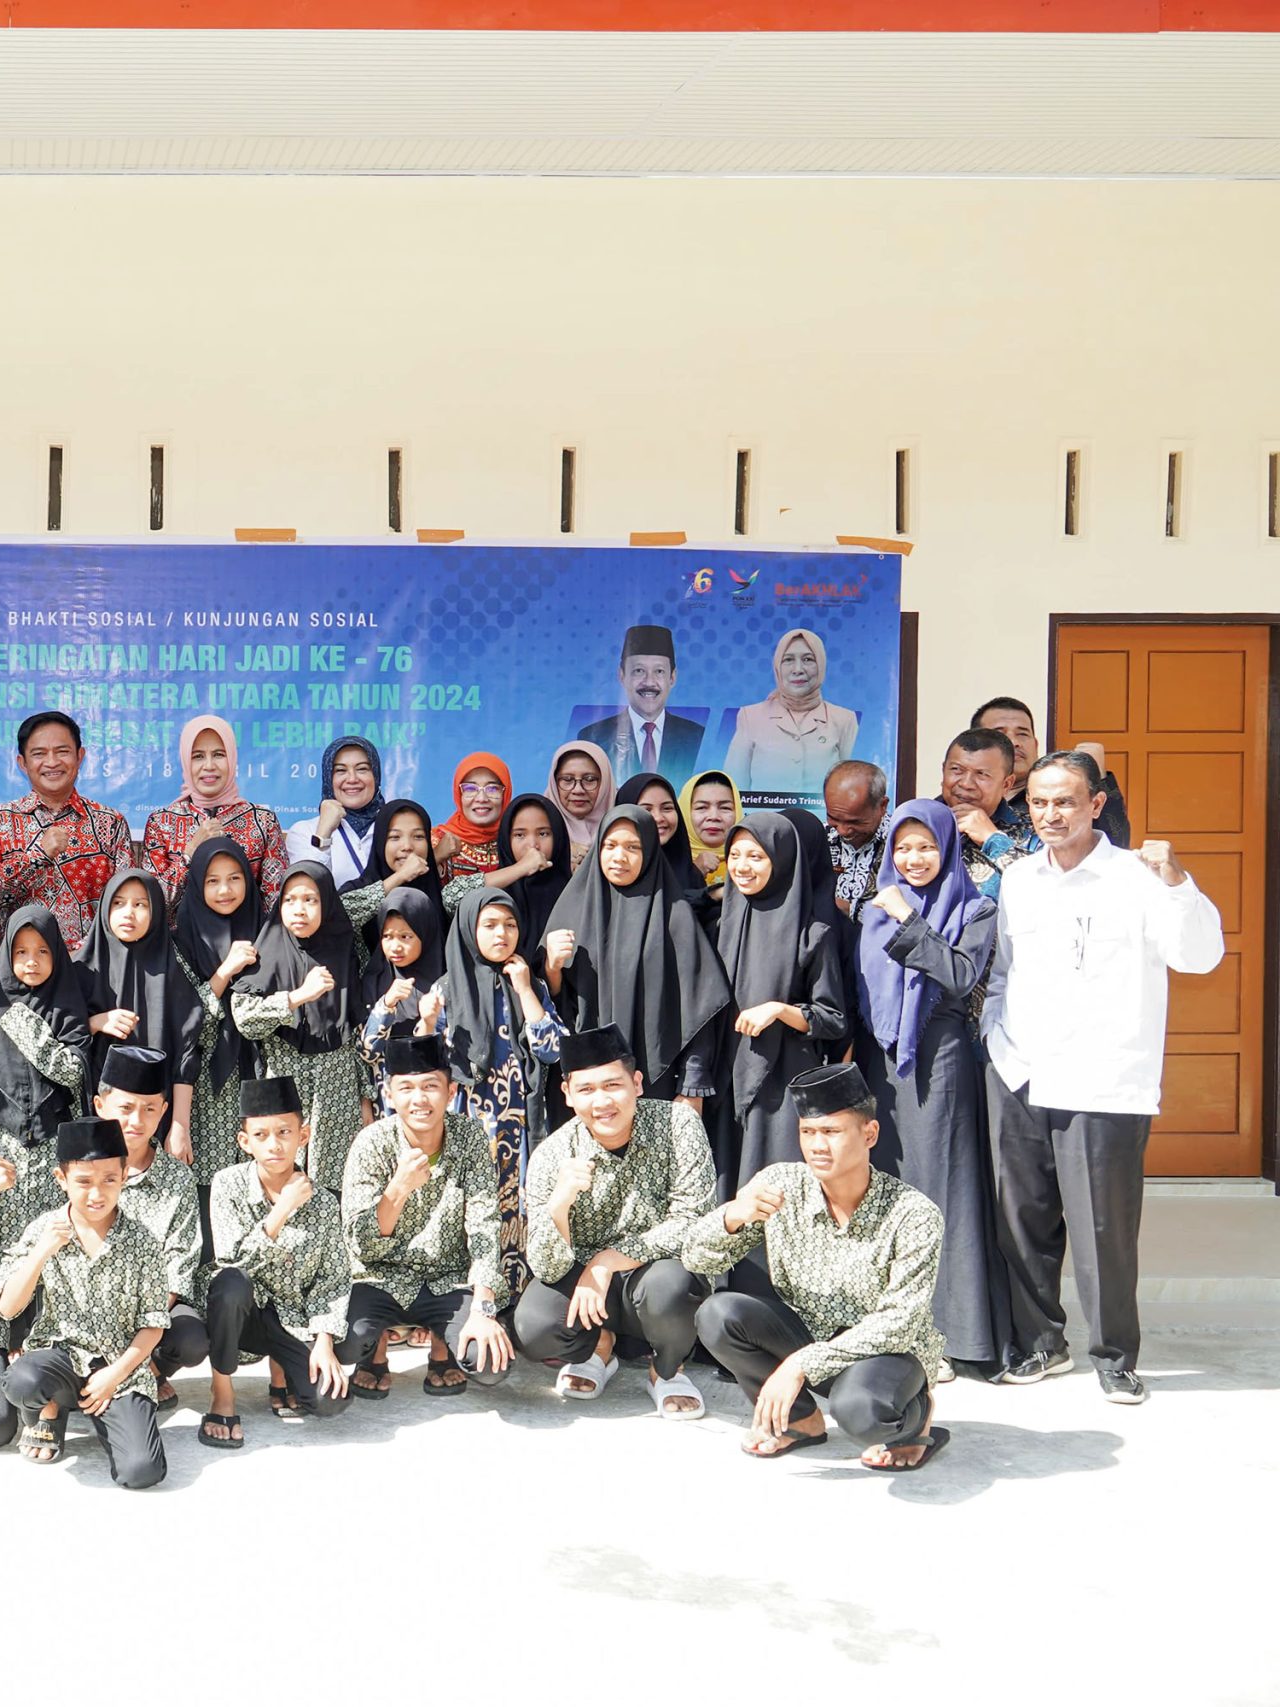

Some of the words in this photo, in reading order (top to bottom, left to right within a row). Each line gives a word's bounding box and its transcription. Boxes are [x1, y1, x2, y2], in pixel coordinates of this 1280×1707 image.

[8, 611, 77, 626] BHAKTI
[88, 611, 156, 626] SOSIAL
[166, 612, 173, 626] /
[184, 612, 299, 627] KUNJUNGAN
[310, 613, 378, 627] SOSIAL
[159, 644, 226, 671] HARI
[235, 645, 300, 671] JADI
[310, 645, 346, 671] KE
[354, 657, 367, 665] -
[377, 645, 413, 672] 76
[45, 682, 199, 709] SUMATERA
[208, 683, 300, 710] UTARA
[307, 683, 400, 710] TAHUN
[410, 684, 481, 711] 2024
[252, 722, 332, 748] LEBIH
[147, 763, 172, 778] 18
[741, 795, 762, 804] Arief
[763, 796, 797, 805] Sudarto
